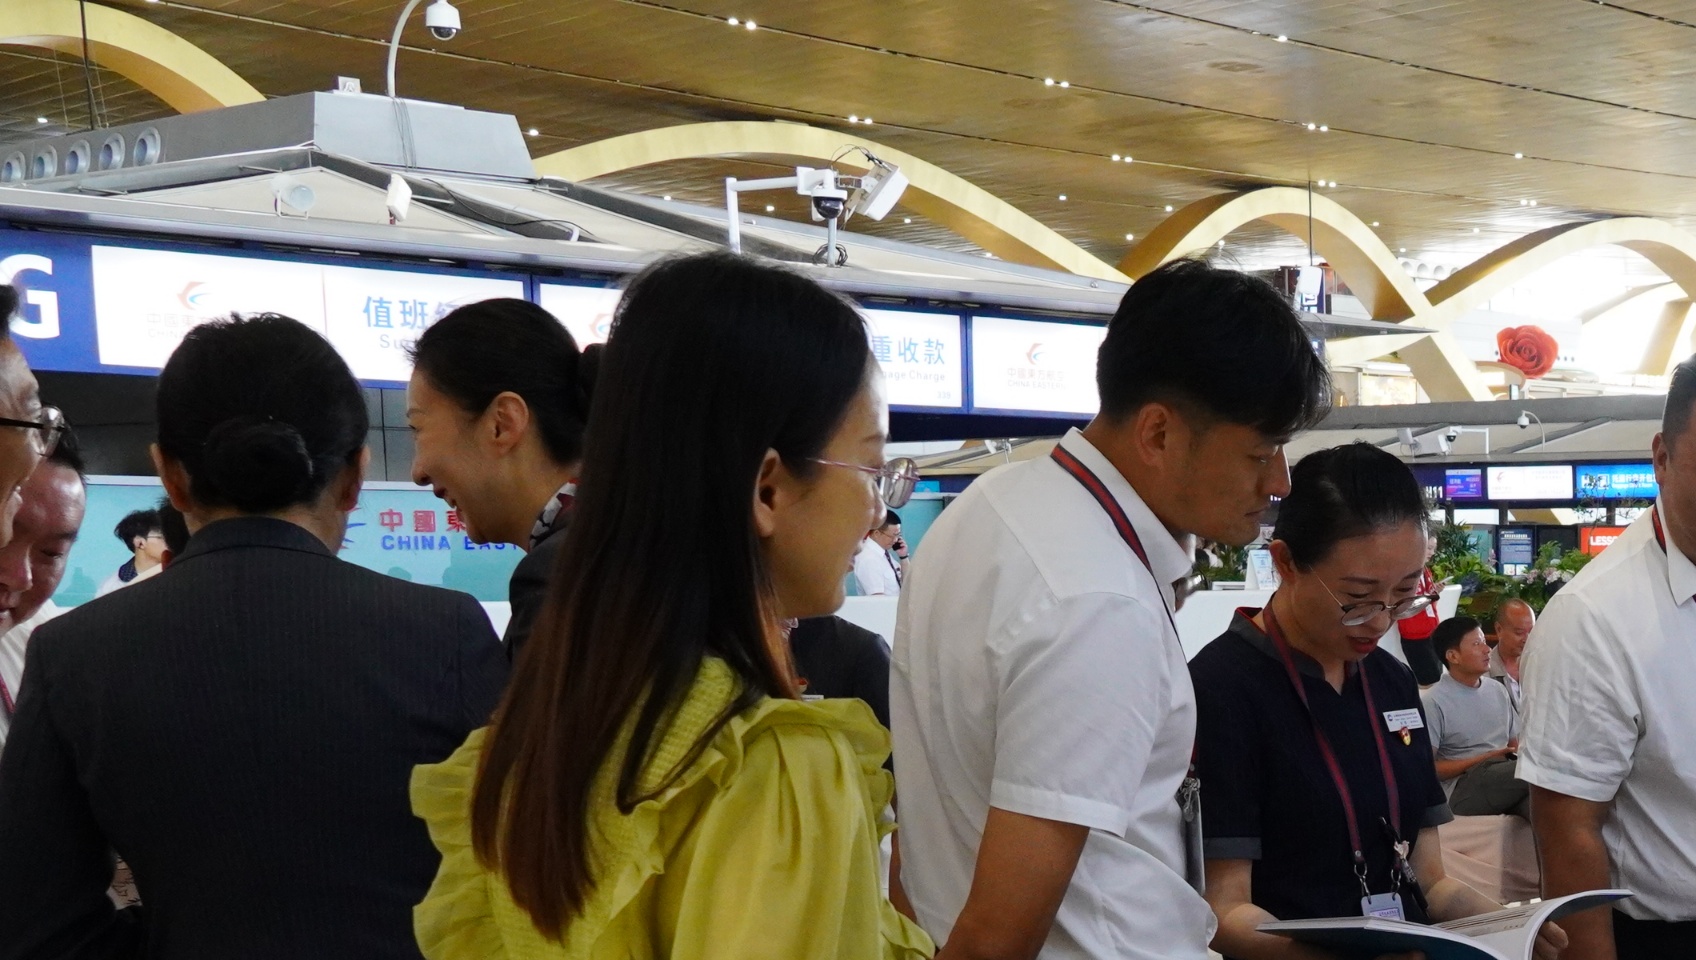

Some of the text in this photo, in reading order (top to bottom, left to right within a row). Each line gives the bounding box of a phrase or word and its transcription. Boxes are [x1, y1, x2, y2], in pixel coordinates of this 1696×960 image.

[0, 253, 60, 339] G
[909, 370, 945, 382] Charge
[381, 535, 451, 551] CHINA
